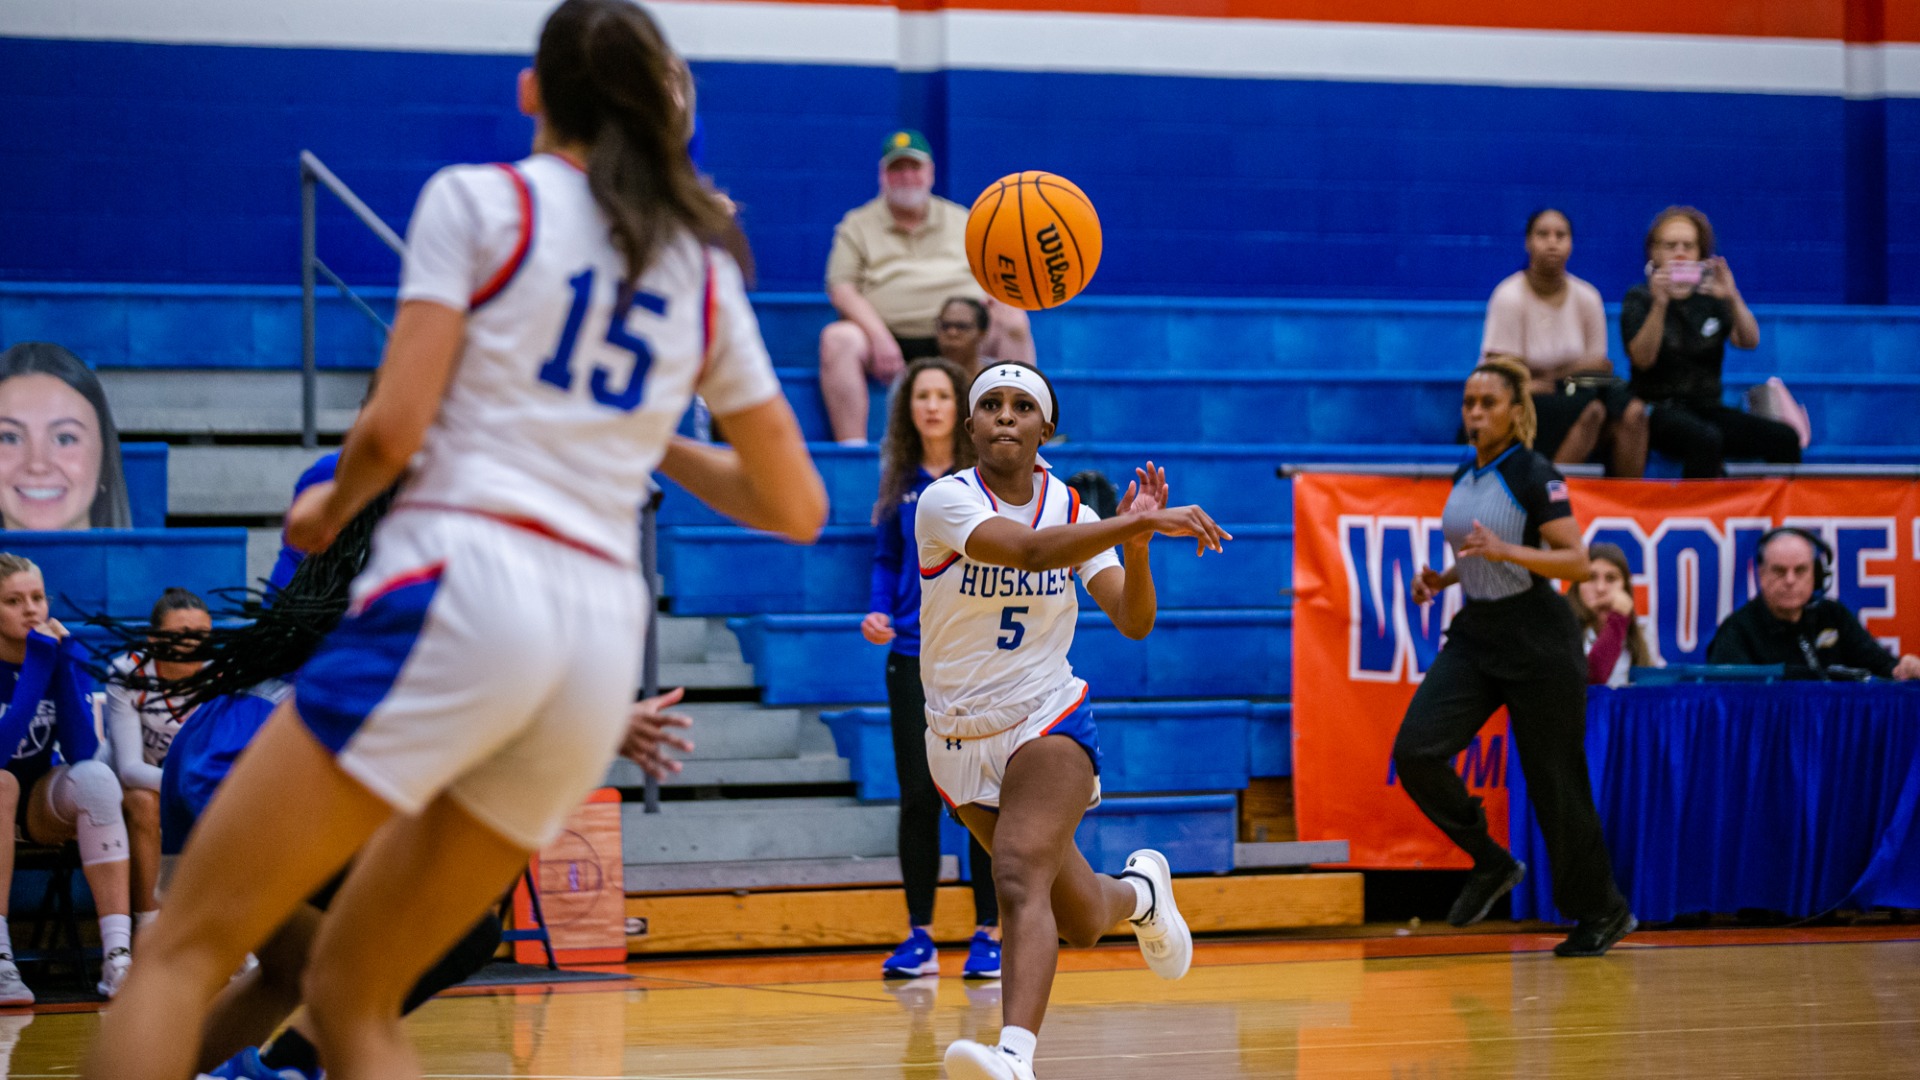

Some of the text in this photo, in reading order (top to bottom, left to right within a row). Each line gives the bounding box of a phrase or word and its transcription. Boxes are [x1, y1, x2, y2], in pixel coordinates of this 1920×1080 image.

[1037, 223, 1068, 303] Wilson
[538, 268, 668, 411] 15
[959, 563, 1067, 598] HUSKIES
[996, 606, 1029, 651] 5
